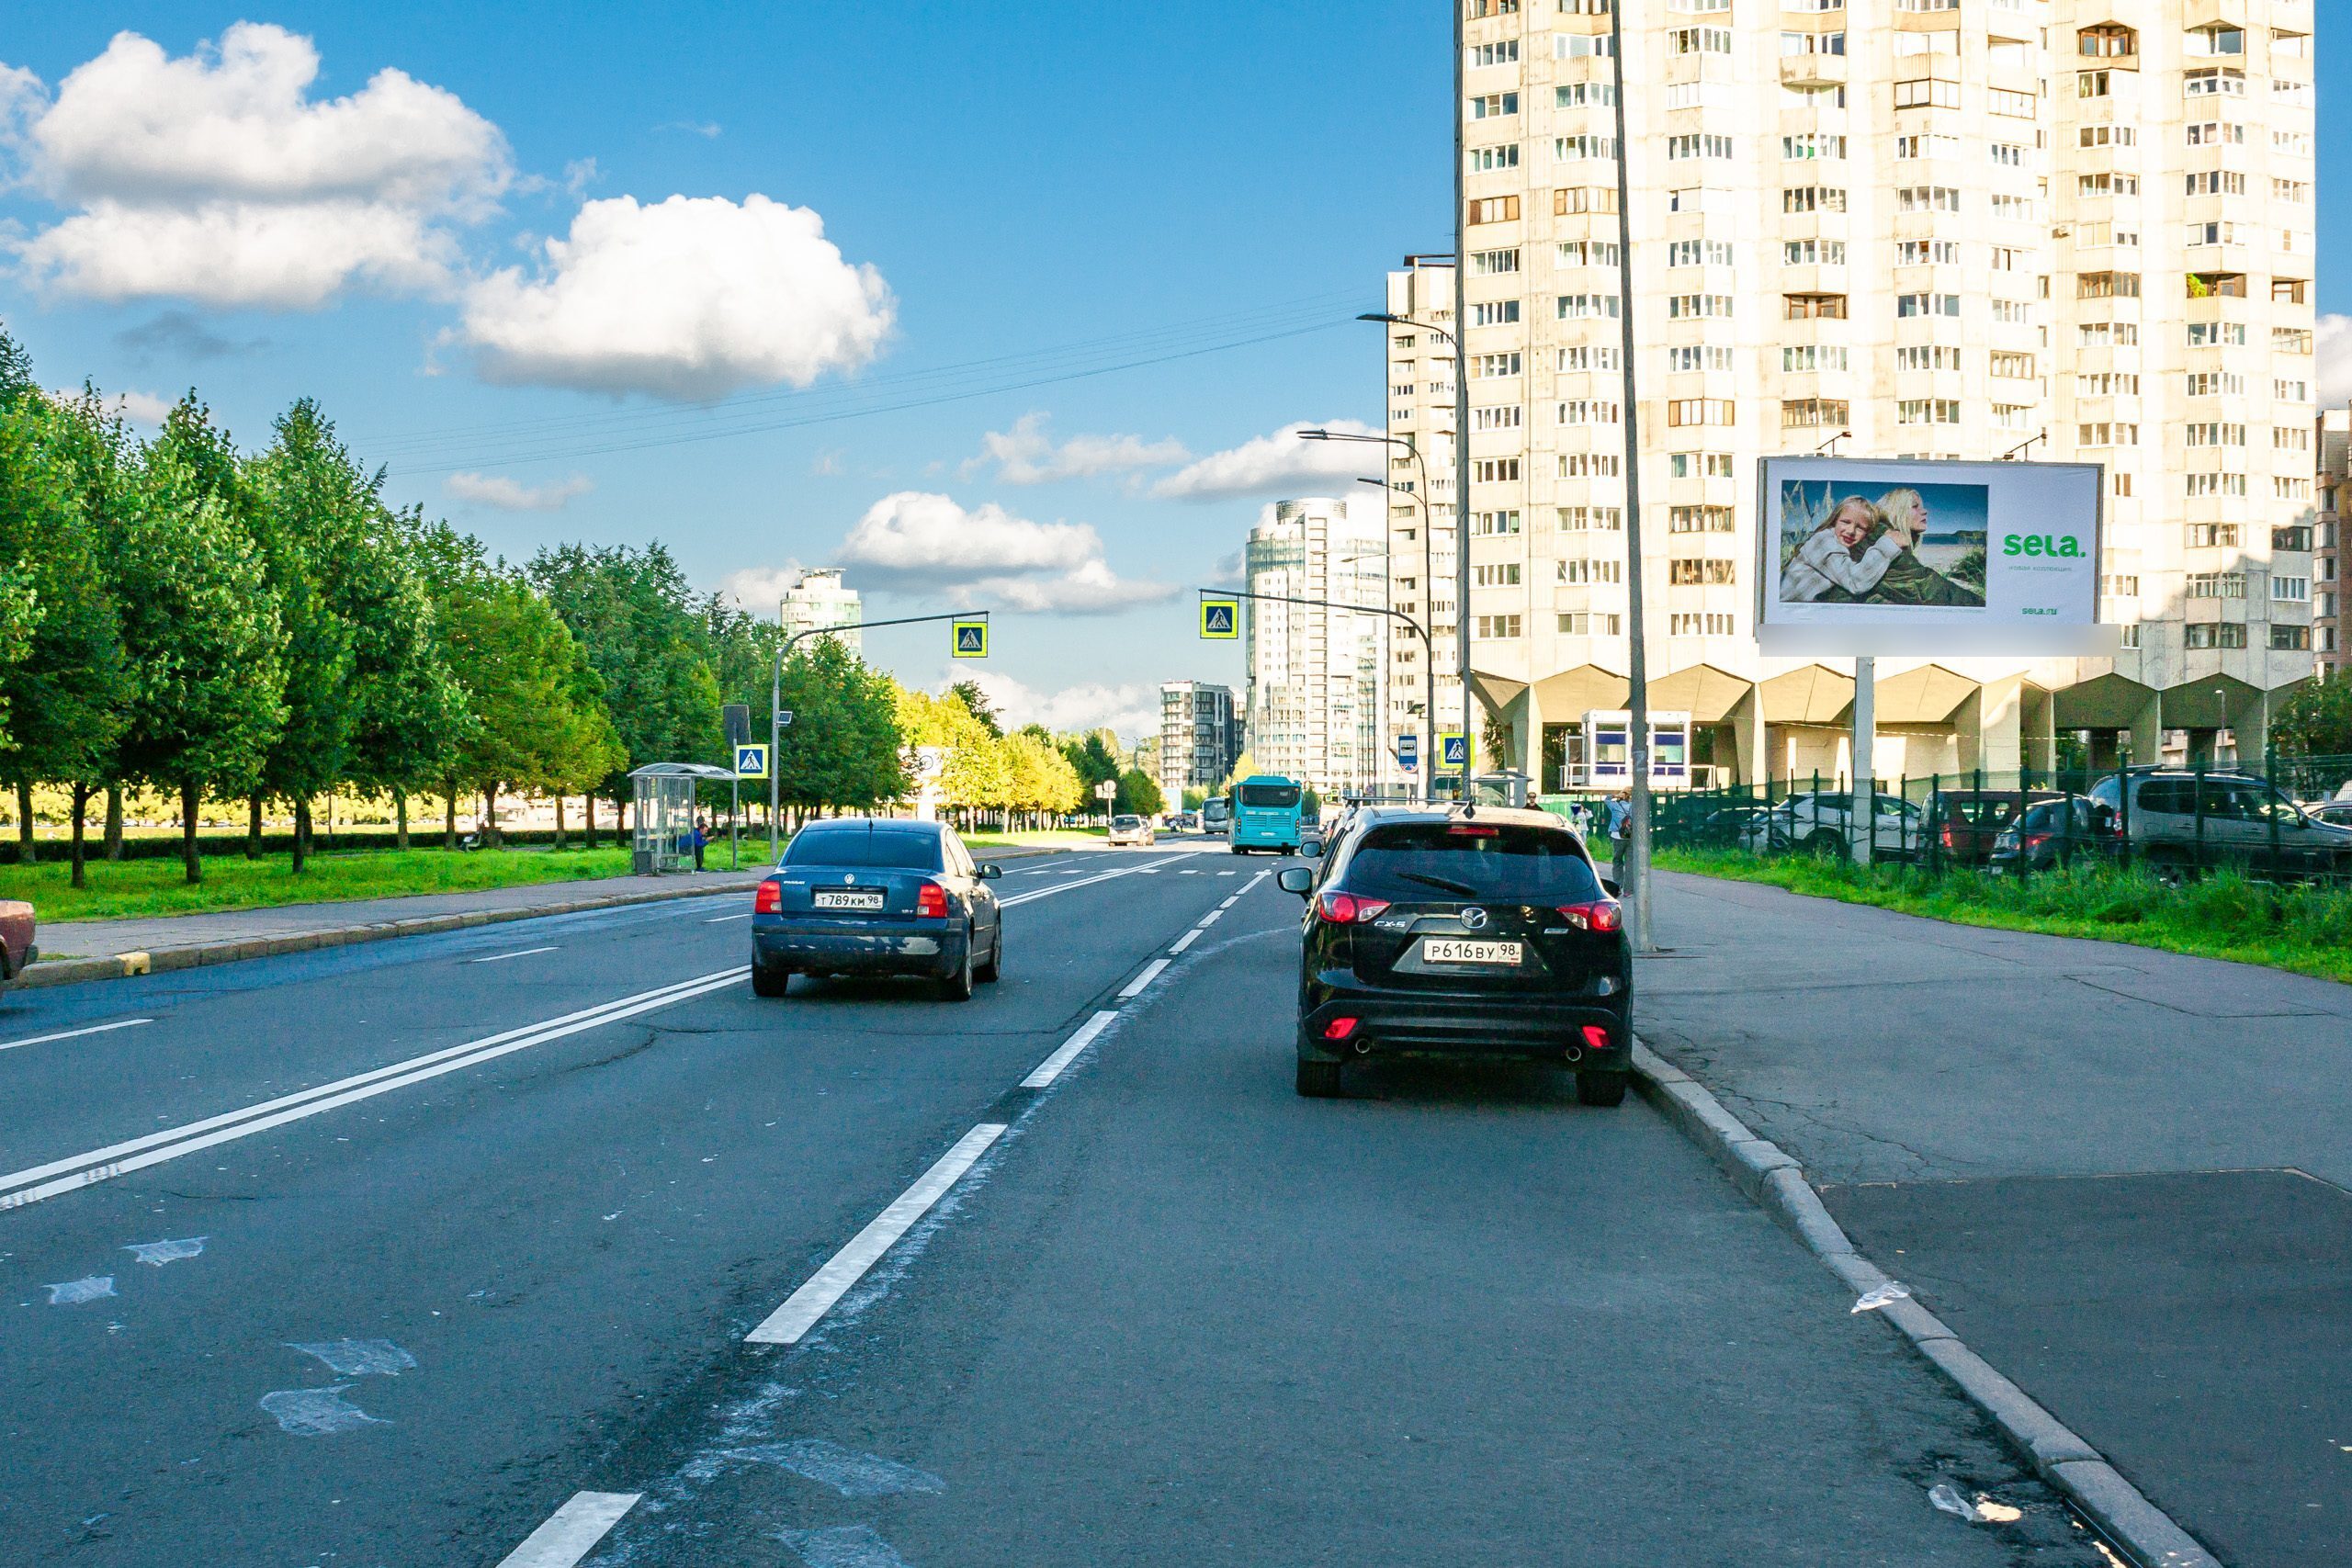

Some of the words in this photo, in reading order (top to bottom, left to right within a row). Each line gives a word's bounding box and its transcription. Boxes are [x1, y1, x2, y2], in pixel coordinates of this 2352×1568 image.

[2002, 534, 2086, 558] sela.
[2021, 607, 2058, 615] sela.ru
[867, 895, 879, 905] 98
[1499, 943, 1516, 956] 98
